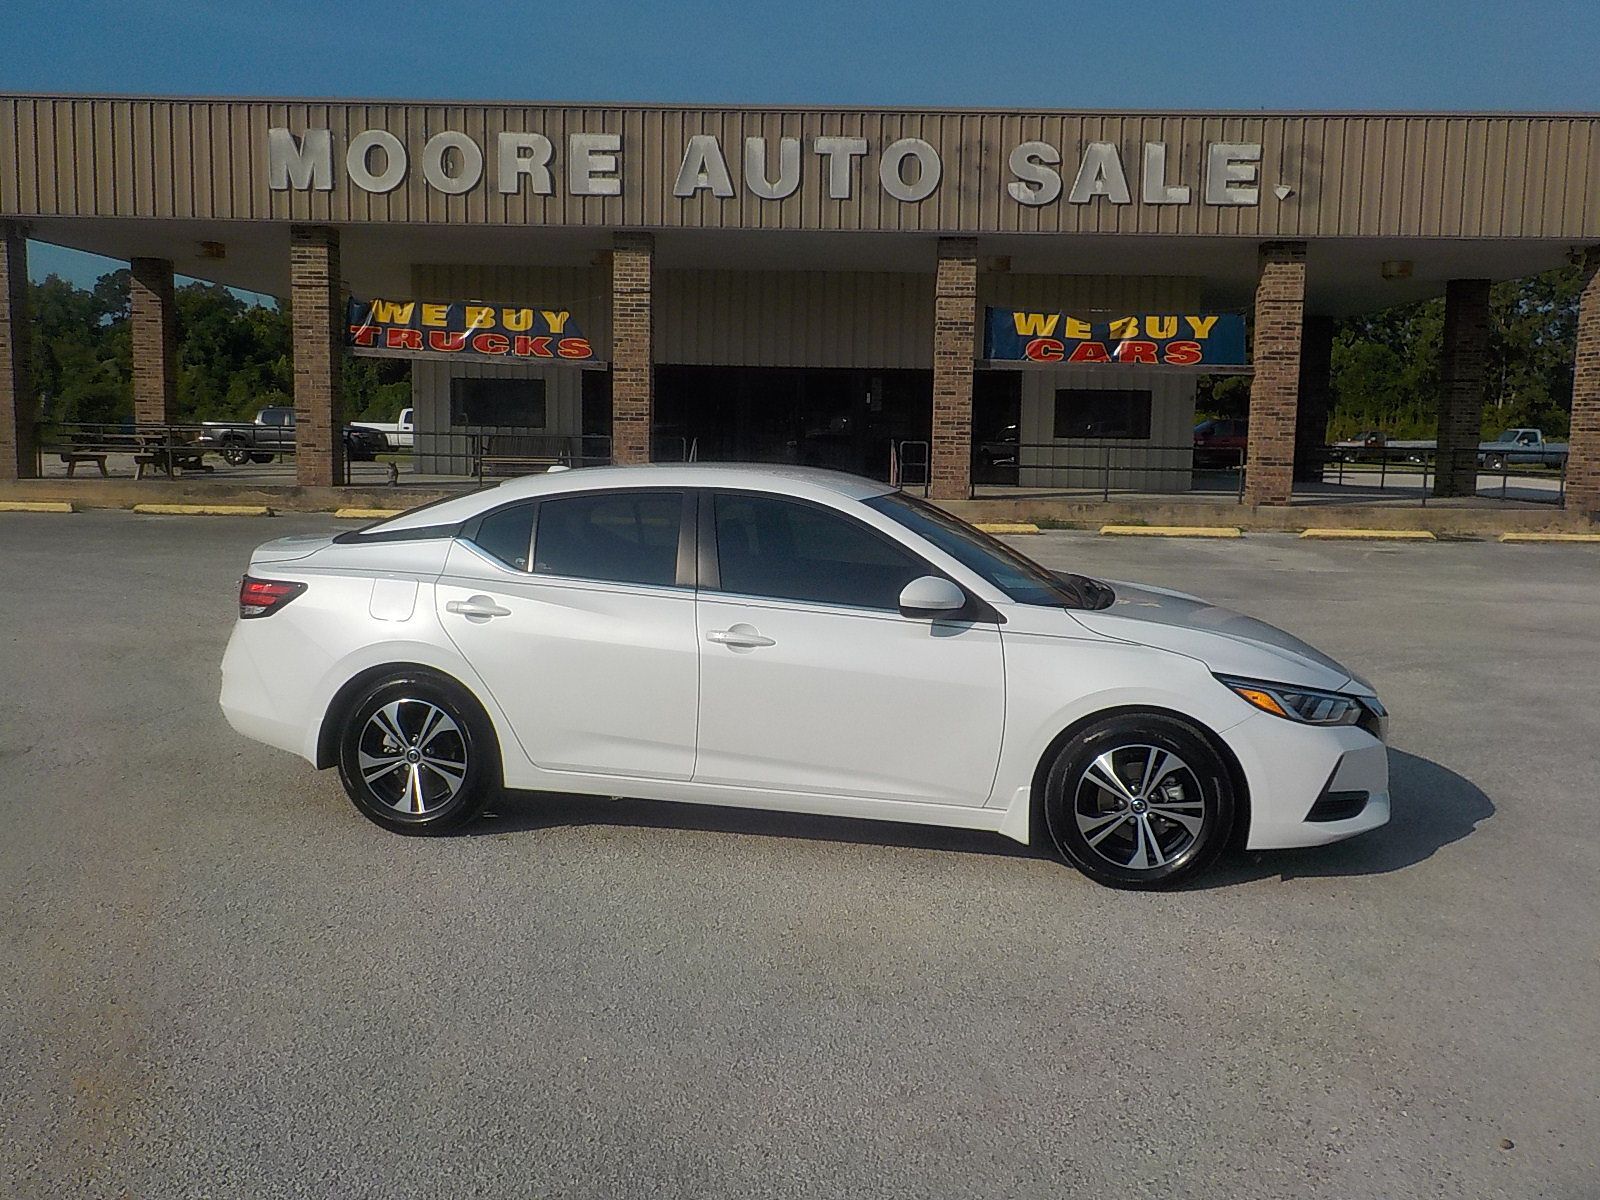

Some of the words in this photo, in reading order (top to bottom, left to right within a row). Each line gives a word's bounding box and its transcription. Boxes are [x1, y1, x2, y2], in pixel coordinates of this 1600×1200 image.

[268, 127, 622, 196] MOORE
[672, 134, 942, 201] AUTO
[370, 299, 449, 327] WE
[465, 306, 569, 334] BUY
[1013, 312, 1092, 340] WE
[1109, 316, 1219, 340] BUY
[350, 325, 593, 359] TRUCKS
[1025, 338, 1202, 366] CARS
